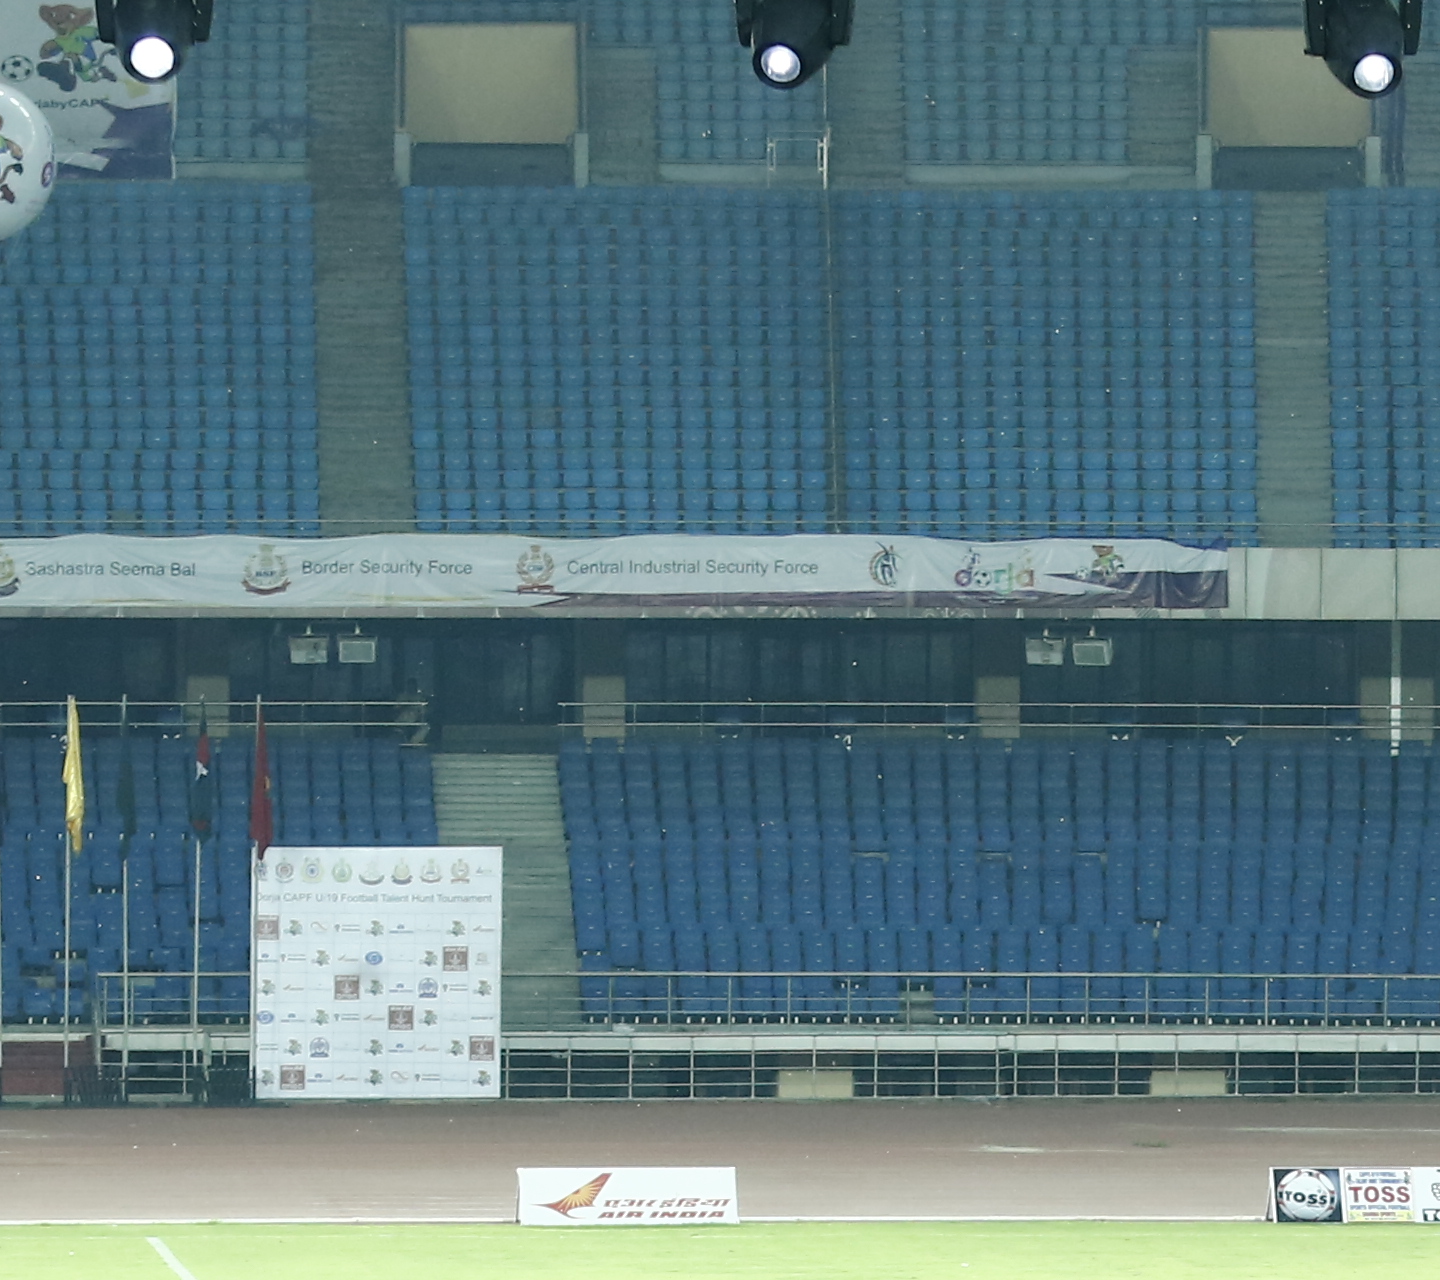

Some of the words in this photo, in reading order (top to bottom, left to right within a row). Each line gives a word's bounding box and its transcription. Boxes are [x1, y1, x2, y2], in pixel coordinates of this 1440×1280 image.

[25, 561, 104, 576] Sashastra
[109, 562, 165, 577] Seema
[170, 562, 196, 577] Bal
[302, 561, 356, 575] Border
[363, 560, 424, 578] Security
[428, 560, 473, 575] Force
[567, 560, 624, 574] Central
[629, 559, 700, 574] Industrial
[705, 559, 768, 577] Security
[774, 559, 819, 573] Force
[412, 894, 434, 902] Hunt
[436, 894, 493, 902] Tournament
[1285, 1191, 1328, 1205] TOSS
[1348, 1186, 1410, 1203] TOSS
[597, 1210, 644, 1219] AIR
[650, 1210, 726, 1219] INDIA
